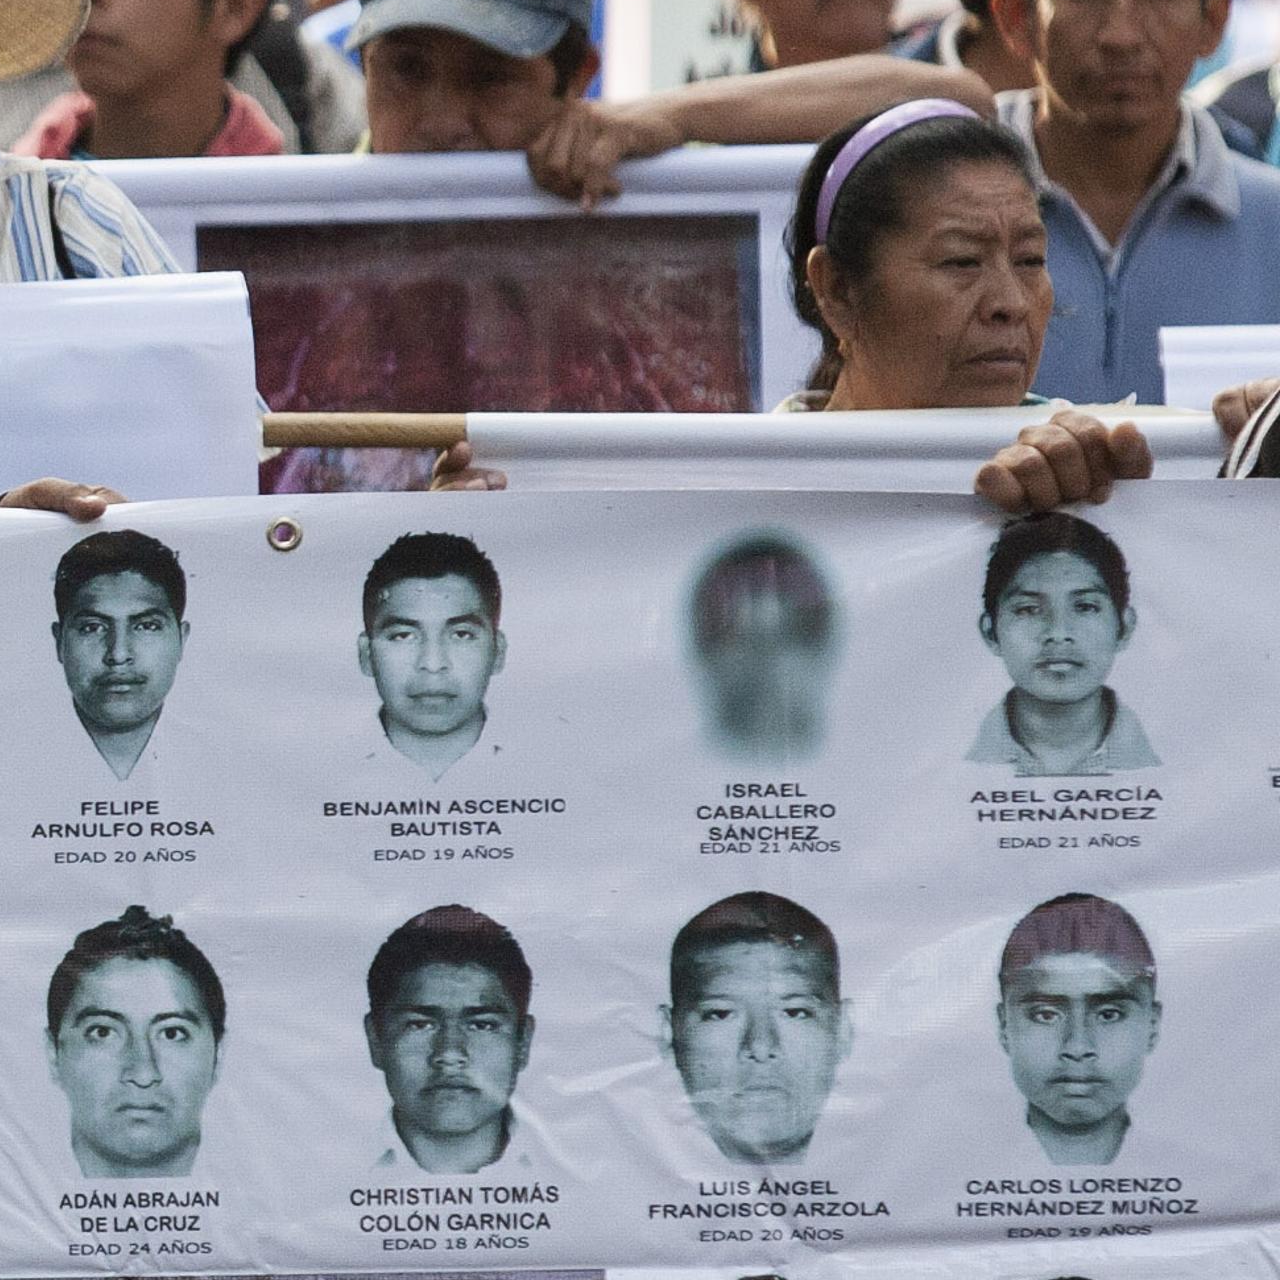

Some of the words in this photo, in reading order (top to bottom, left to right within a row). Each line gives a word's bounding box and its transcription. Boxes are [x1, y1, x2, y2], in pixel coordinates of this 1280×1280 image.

[726, 783, 808, 799] ISRAEL
[970, 791, 1046, 804] ABEL
[1053, 787, 1163, 803] GARCÍA
[81, 801, 160, 817] FELIPE
[324, 800, 441, 817] BENJAMÍN
[448, 799, 566, 815] ASCENCIO
[697, 804, 836, 821] CABALLERO
[978, 806, 1157, 822] HERNÁNDEZ
[32, 822, 144, 839] ARNULFO
[151, 821, 215, 837] ROSA
[391, 821, 502, 837] BAUTISTA
[709, 825, 820, 842] SÁNCHEZ
[55, 852, 108, 864] EDAD
[115, 851, 137, 864] 20
[143, 848, 197, 863] AÑOS
[350, 1188, 473, 1207] CHRISTIAN
[479, 1183, 560, 1205] TOMÁS
[700, 1181, 751, 1197] LUIS
[758, 1178, 839, 1196] ÁNGEL
[966, 1179, 1063, 1196] CARLOS
[1069, 1178, 1183, 1194] LORENZO
[60, 1190, 117, 1210] ADÁN
[123, 1192, 220, 1209] ABRAJAN
[957, 1199, 1105, 1217] HERNÁNDEZ
[1112, 1197, 1199, 1216] MUÑOZ
[649, 1202, 787, 1220] FRANCISCO
[793, 1202, 891, 1218] ARZOLA
[81, 1217, 108, 1233] DE
[114, 1217, 140, 1233] LA
[144, 1215, 201, 1233] CRUZ
[360, 1211, 440, 1233] COLÓN
[447, 1212, 551, 1232] GARNICA
